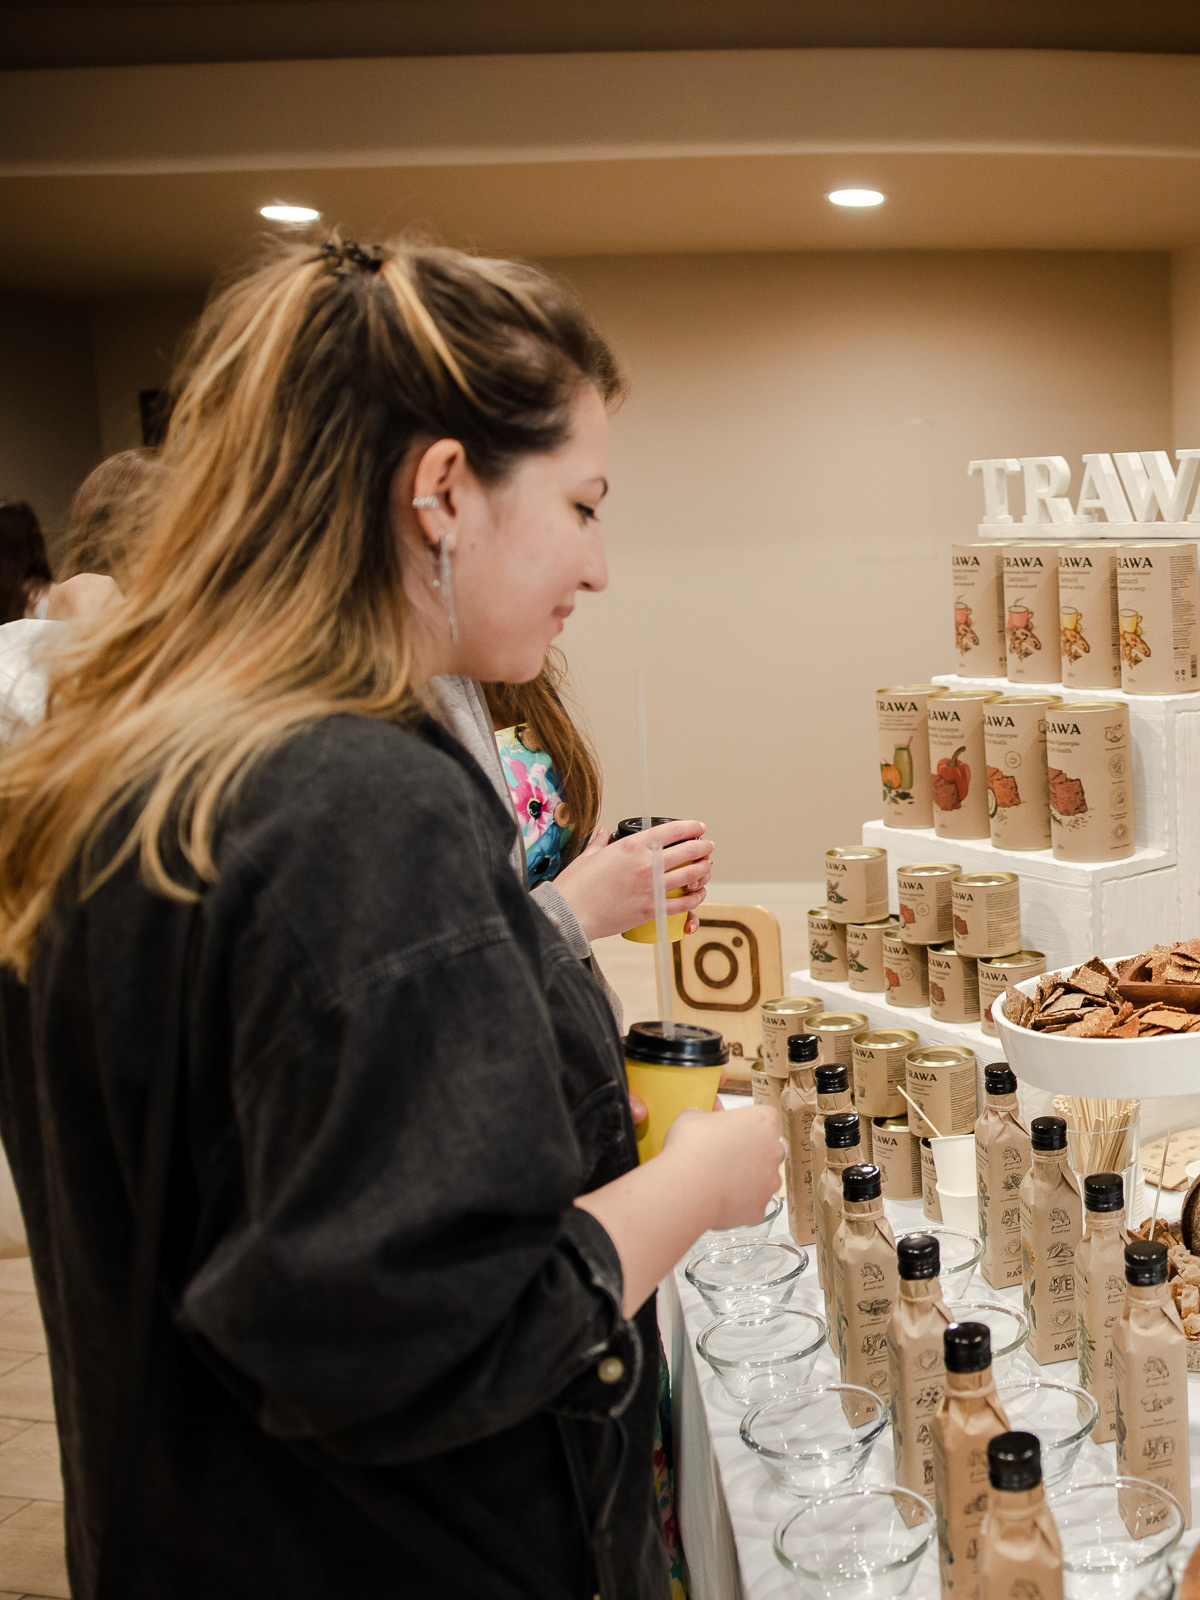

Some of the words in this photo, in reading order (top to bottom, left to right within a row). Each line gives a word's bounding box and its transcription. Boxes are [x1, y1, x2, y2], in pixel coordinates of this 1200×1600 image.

[952, 556, 981, 566] AWA
[1059, 557, 1093, 568] RAWA
[1117, 557, 1154, 569] RAWA
[928, 709, 961, 721] RAWA
[983, 714, 1015, 727] AWA
[1047, 721, 1081, 735] RAWA
[898, 880, 924, 891] RAWA
[951, 889, 974, 902] AWA
[884, 944, 909, 956] RAWA
[929, 957, 951, 970] RAWA
[762, 1015, 787, 1027] RAWA
[853, 1048, 875, 1060] AWA
[873, 1132, 898, 1146] RAWA
[1054, 1340, 1076, 1352] RAW
